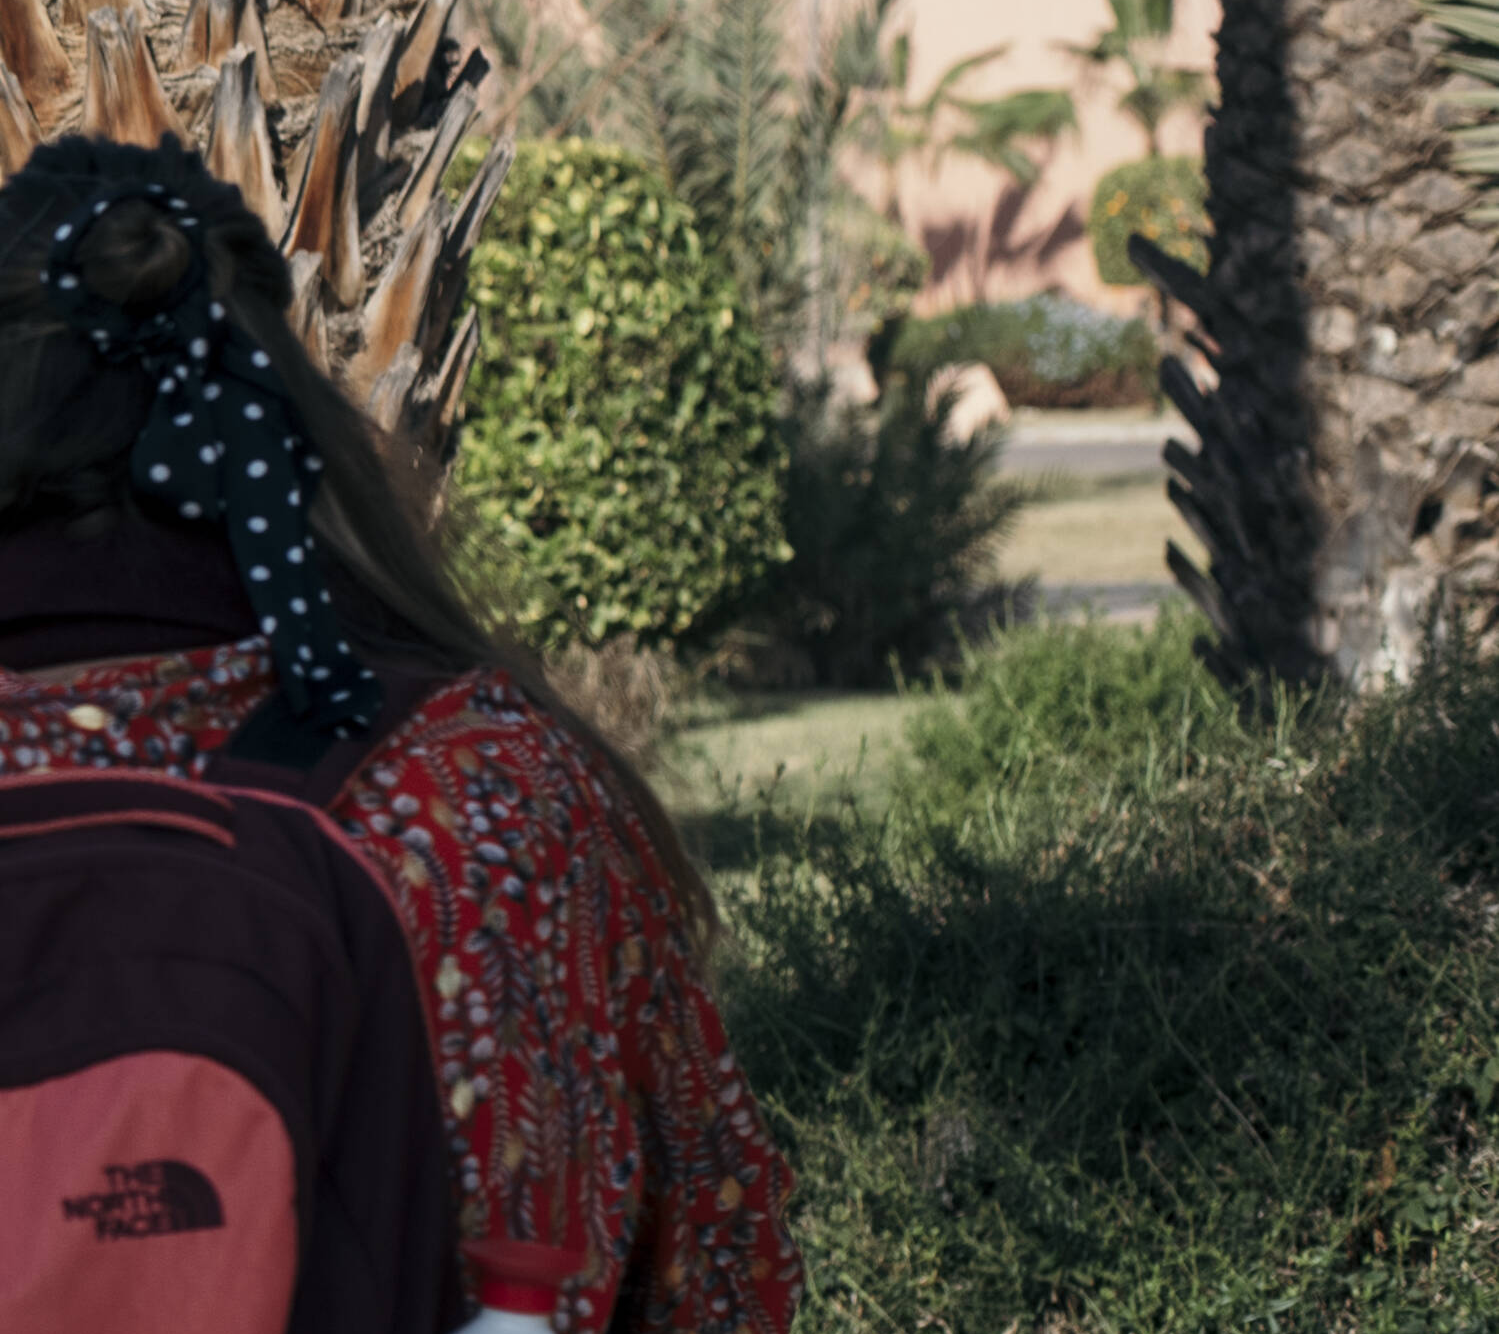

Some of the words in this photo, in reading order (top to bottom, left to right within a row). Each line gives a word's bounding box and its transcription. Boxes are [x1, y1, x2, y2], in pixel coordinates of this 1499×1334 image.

[102, 1162, 161, 1190] THE
[61, 1188, 168, 1219] NORTH
[95, 1214, 174, 1241] FACE
